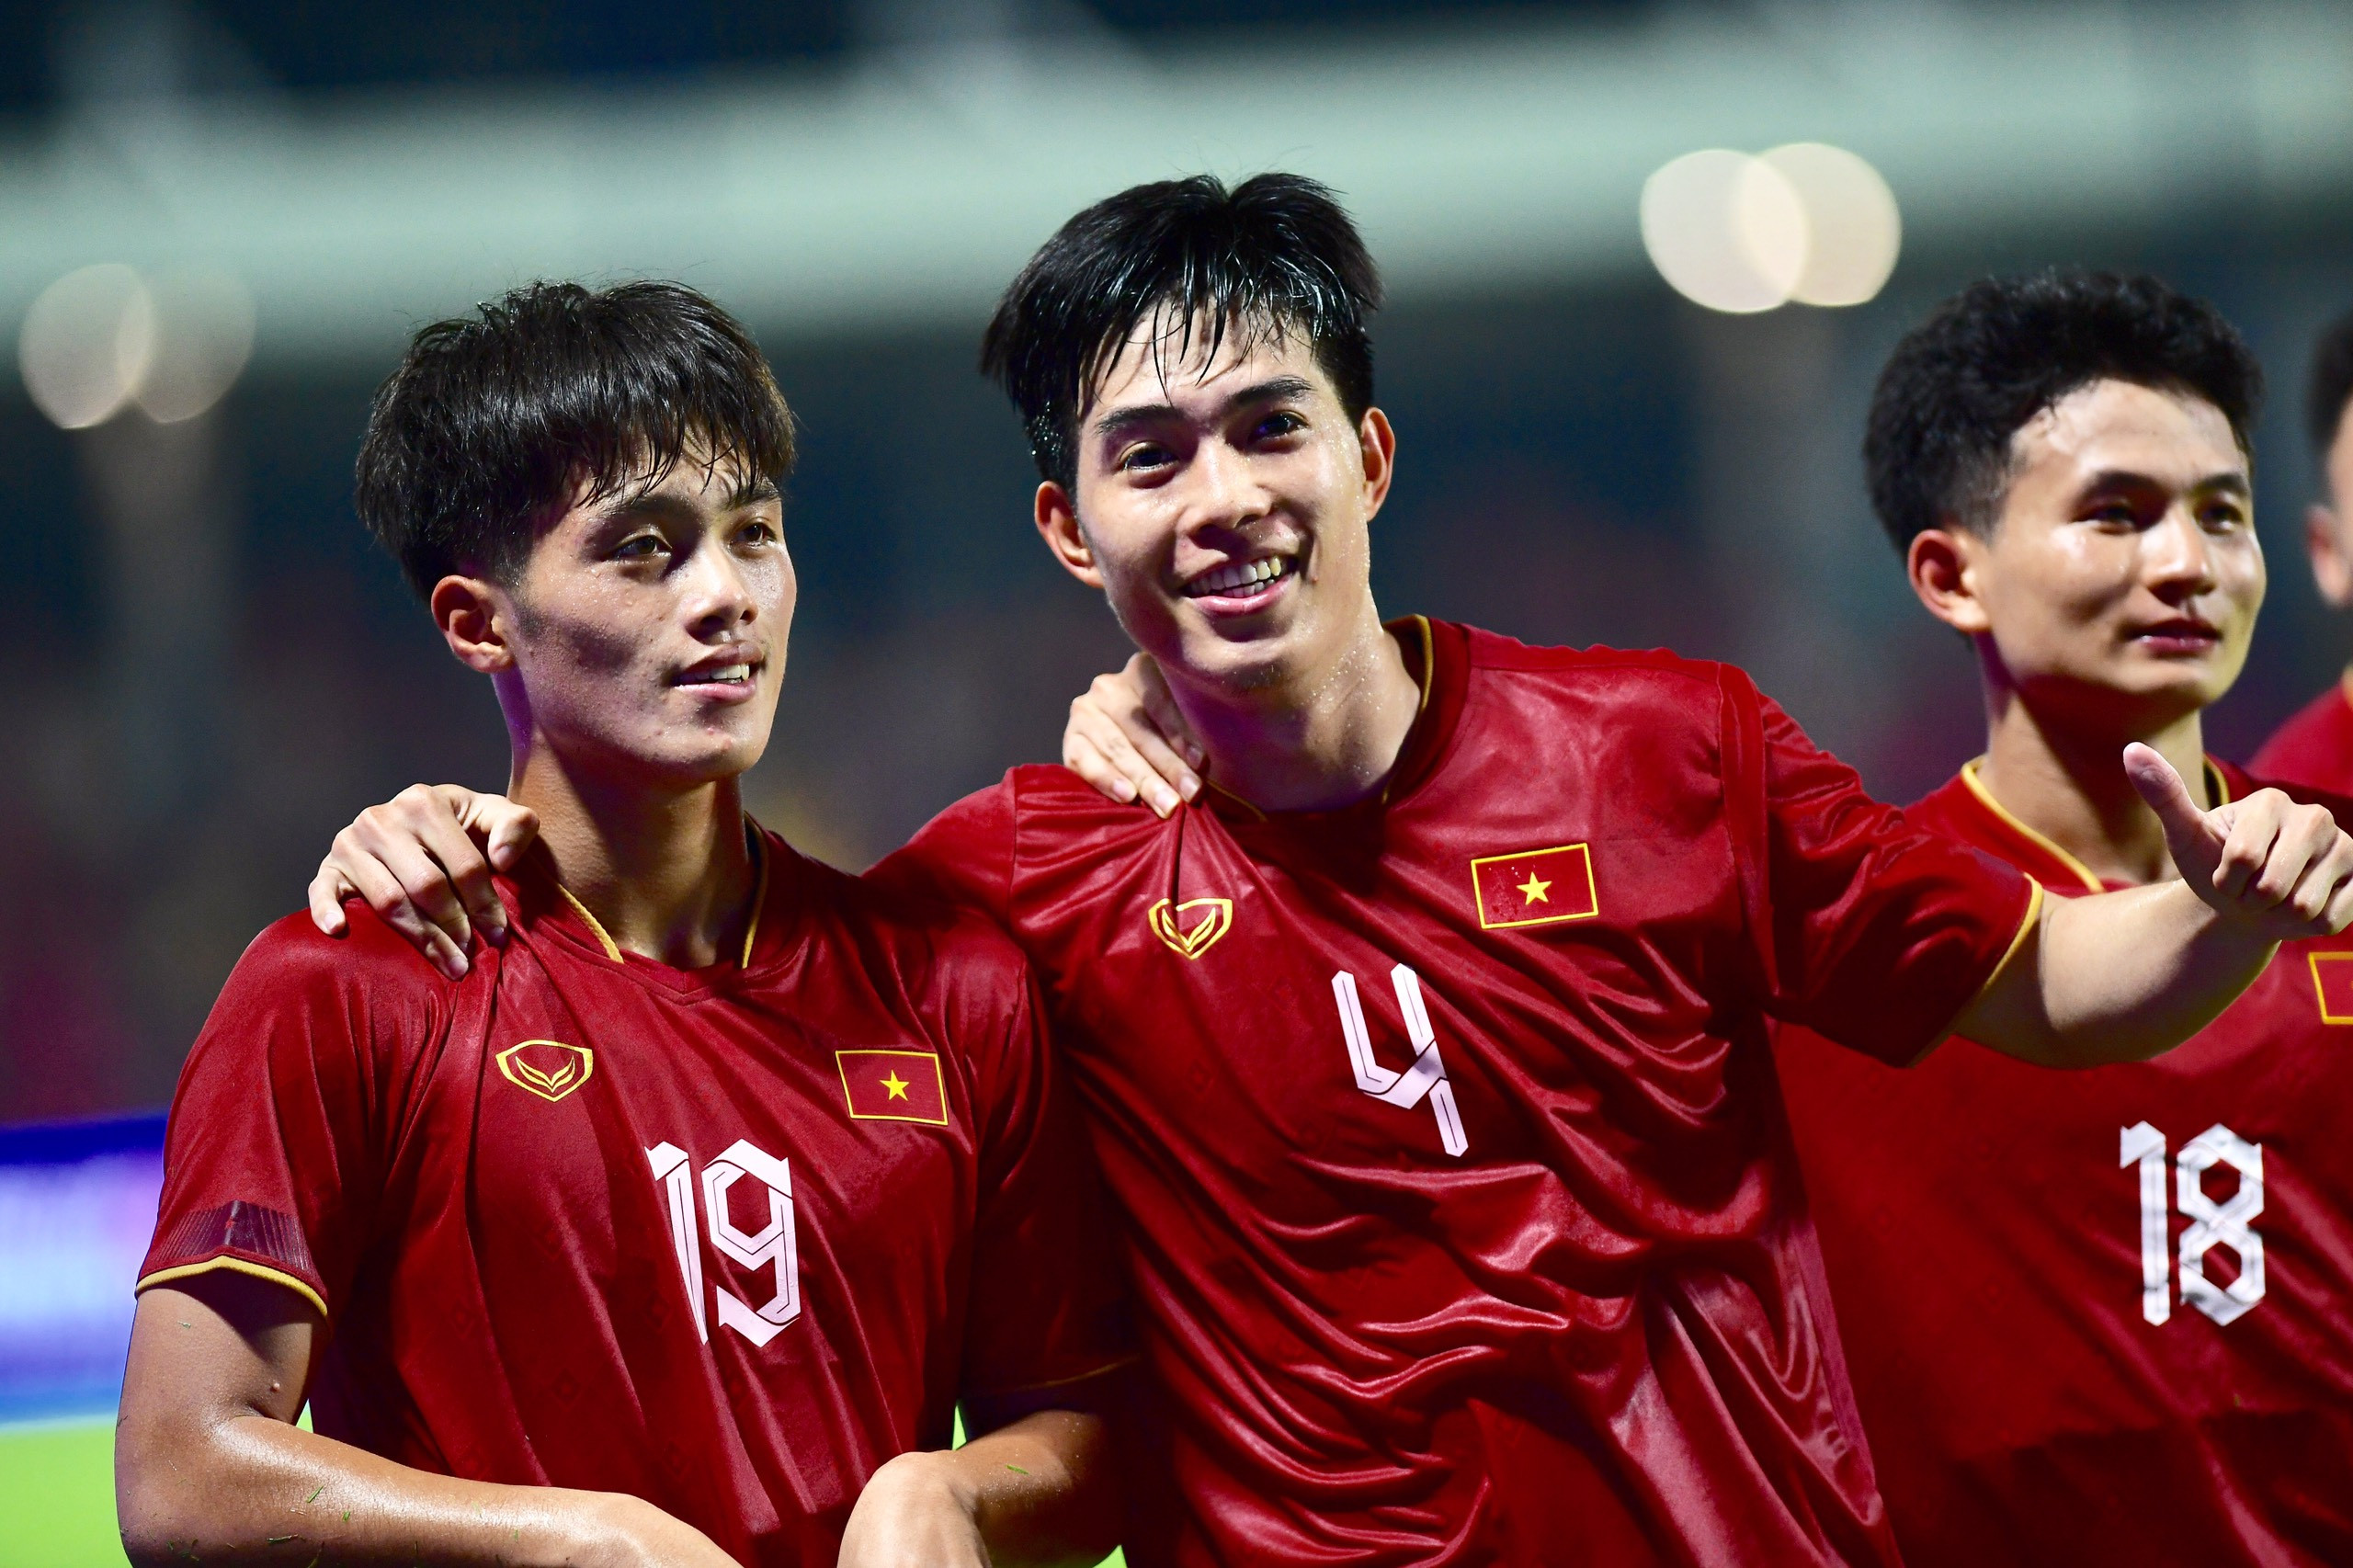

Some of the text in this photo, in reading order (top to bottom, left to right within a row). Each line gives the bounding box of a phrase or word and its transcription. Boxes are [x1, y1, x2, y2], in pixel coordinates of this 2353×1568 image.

[1331, 963, 1469, 1157] 4
[644, 1139, 801, 1347] 19
[2120, 1120, 2266, 1326] 18
